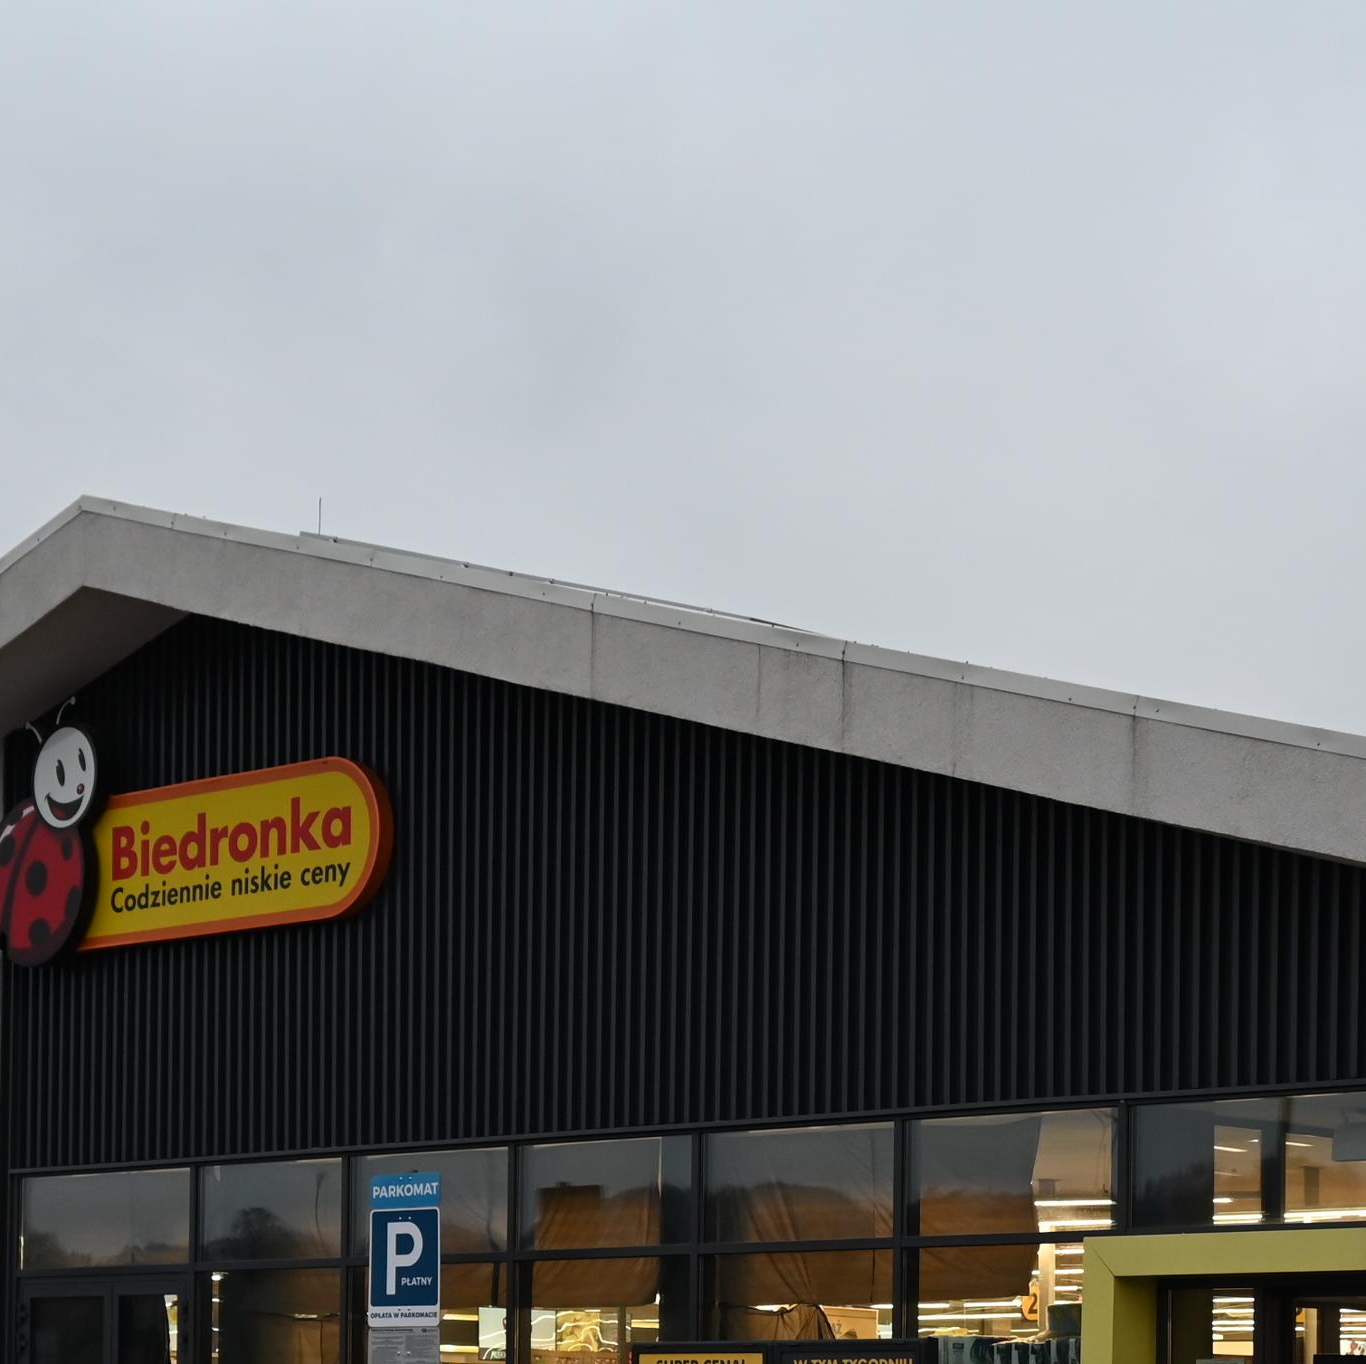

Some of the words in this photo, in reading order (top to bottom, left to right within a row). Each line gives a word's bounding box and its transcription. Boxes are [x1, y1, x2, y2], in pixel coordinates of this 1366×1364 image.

[111, 796, 353, 881] Biedronka
[110, 875, 223, 914] Codziennie
[230, 863, 292, 896] niskie
[300, 860, 352, 887] ceny
[372, 1182, 439, 1199] PARKOMAT
[386, 1221, 423, 1295] P
[401, 1276, 432, 1286] PŁATNY
[401, 1311, 437, 1319] PARKOMACIE
